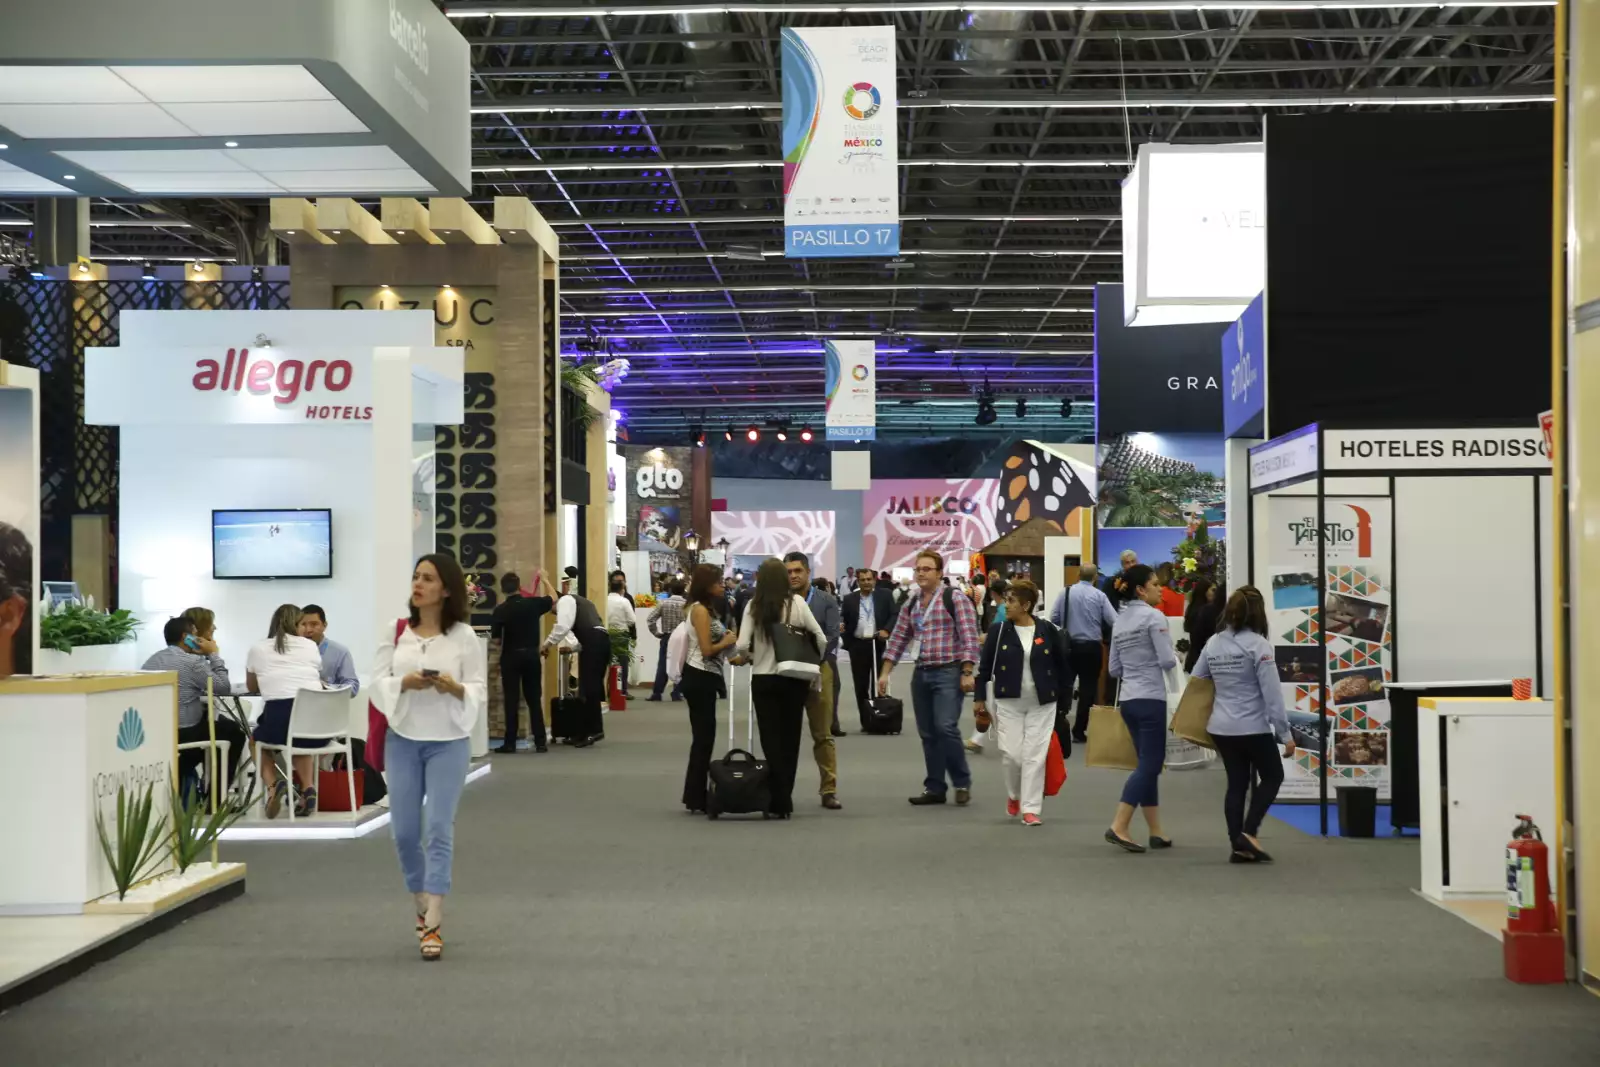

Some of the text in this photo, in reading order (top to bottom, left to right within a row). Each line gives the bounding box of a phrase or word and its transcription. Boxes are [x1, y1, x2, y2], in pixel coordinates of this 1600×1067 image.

[792, 229, 892, 246] PASILLO 17
[192, 348, 353, 404] allegro
[1167, 376, 1218, 390] GRA
[306, 406, 373, 420] HOTELS
[828, 427, 863, 436] PASILLO
[1340, 440, 1445, 458] HOTELES
[636, 460, 684, 498] gto
[886, 496, 977, 515] JALISCO
[905, 519, 916, 527] ES
